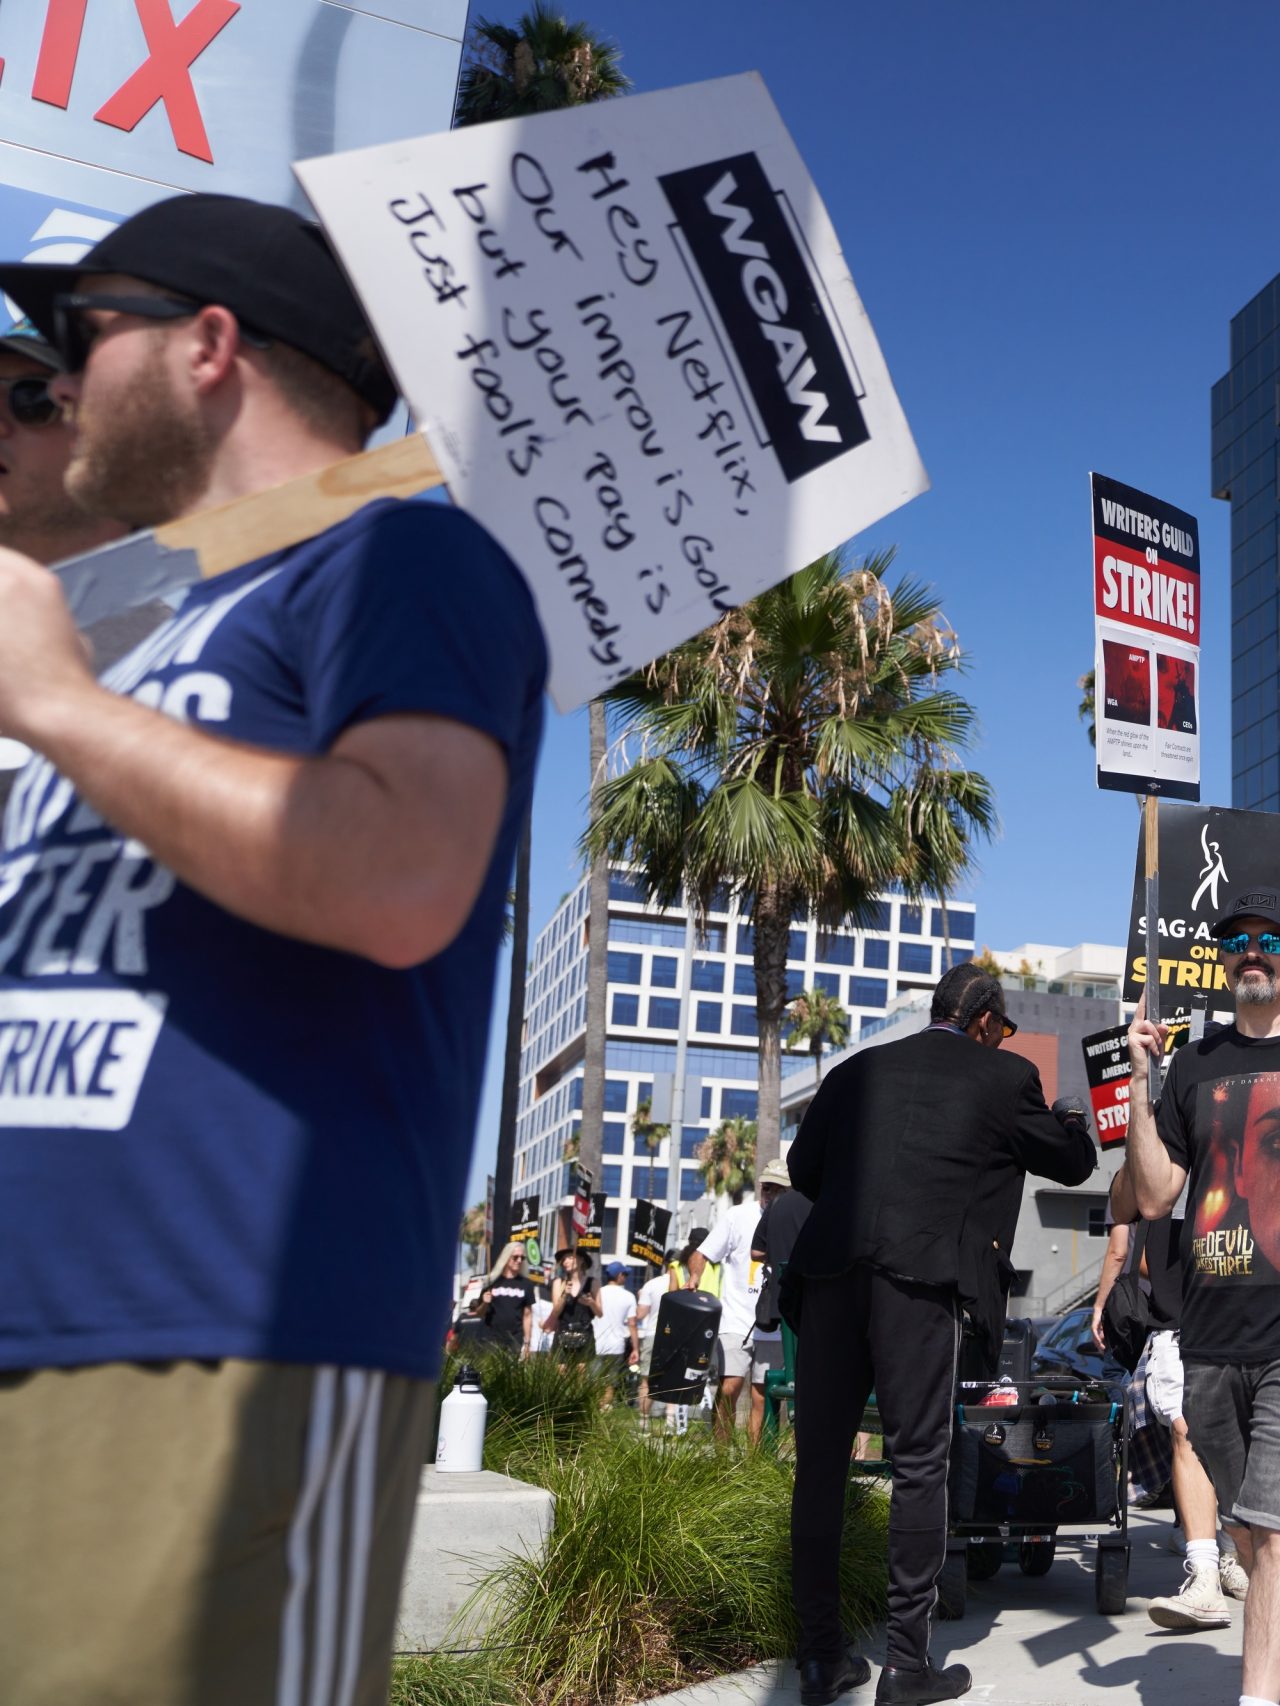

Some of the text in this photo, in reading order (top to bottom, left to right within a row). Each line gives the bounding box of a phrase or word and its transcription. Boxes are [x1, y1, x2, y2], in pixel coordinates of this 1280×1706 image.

[389, 193, 468, 310] Just
[704, 171, 843, 444] WGAW
[512, 151, 584, 262] Our
[656, 469, 694, 527] is
[576, 151, 758, 517] Hey Netflix,
[454, 184, 527, 279] but
[503, 307, 592, 427] your
[638, 565, 671, 616] is
[1101, 498, 1194, 558] WRITERS GUILD
[1145, 546, 1158, 566] ON
[1102, 556, 1195, 634] STRIKE!
[1190, 945, 1218, 961] ON
[1131, 956, 1231, 991] STRIK
[0, 1020, 138, 1097] RIKE
[1086, 1037, 1120, 1057] WRITERS
[1111, 1052, 1121, 1062] OF
[1102, 1063, 1132, 1080] AMERIC
[1115, 1086, 1129, 1099] ON
[1097, 1104, 1130, 1130] STRI
[1193, 1224, 1254, 1257] THE DEVIL
[1212, 1255, 1254, 1276] THREE
